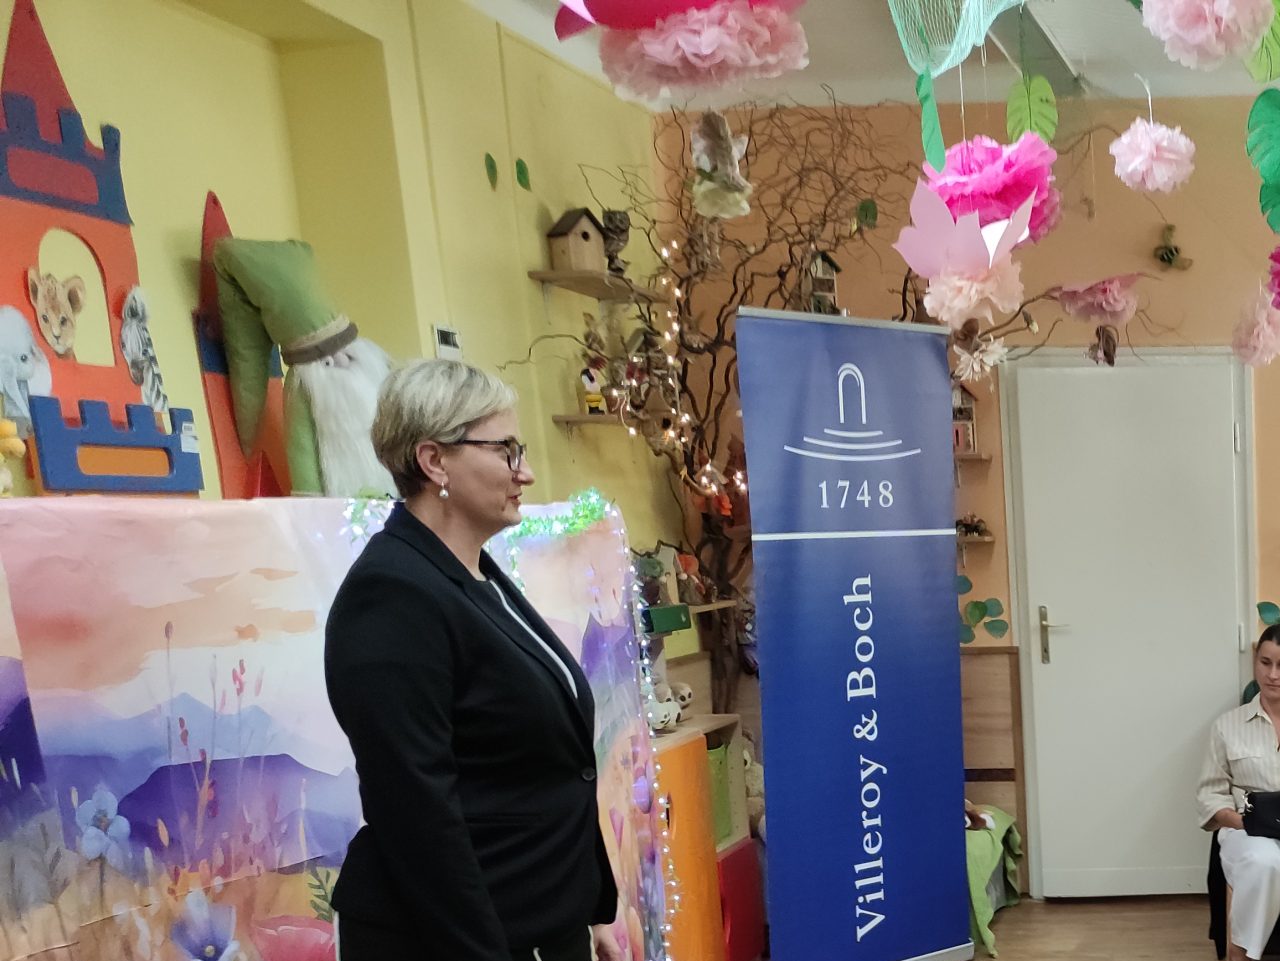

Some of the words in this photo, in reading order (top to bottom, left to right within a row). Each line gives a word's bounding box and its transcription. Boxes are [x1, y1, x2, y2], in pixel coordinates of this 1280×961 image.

[817, 478, 894, 509] 1748
[842, 573, 877, 702] Boch
[853, 709, 878, 741] &
[852, 753, 888, 942] Villeroy
